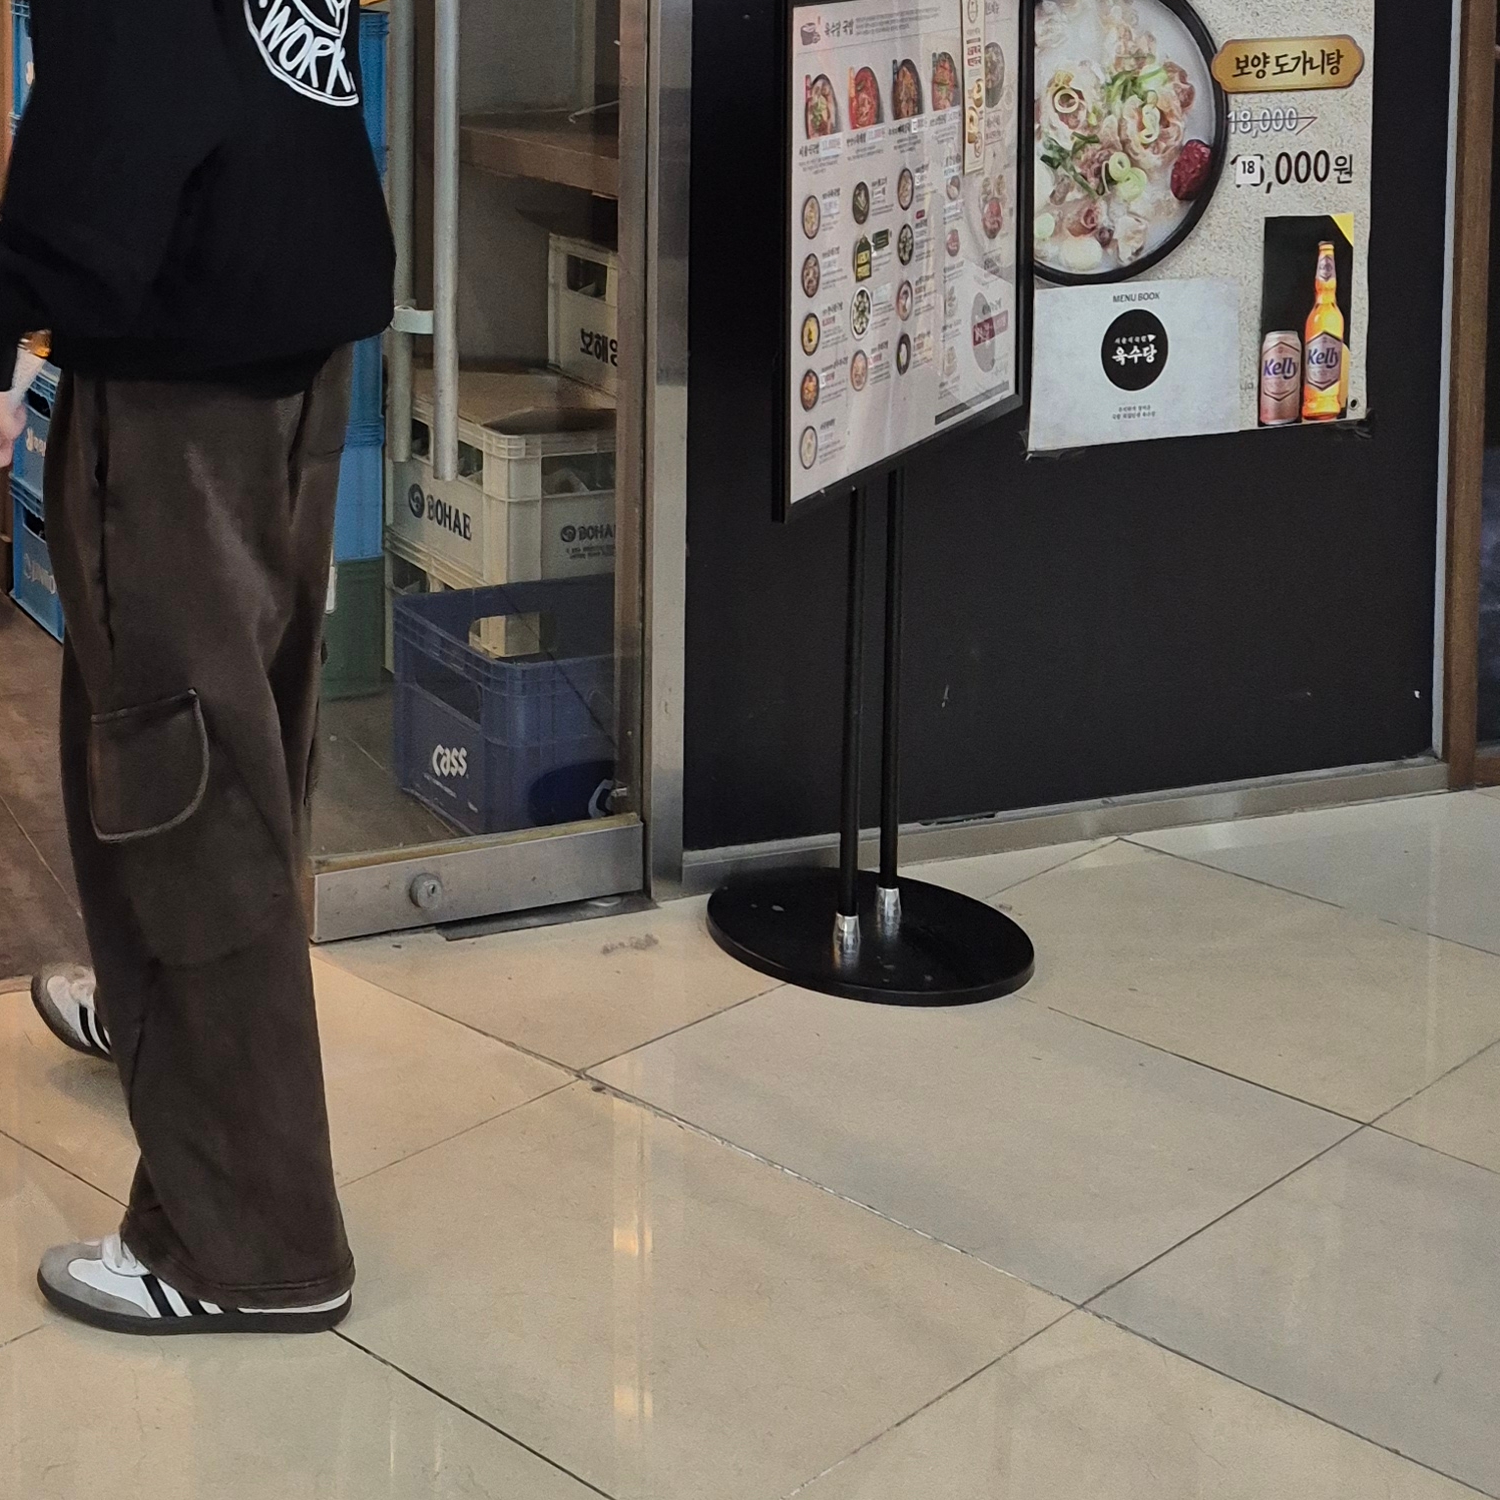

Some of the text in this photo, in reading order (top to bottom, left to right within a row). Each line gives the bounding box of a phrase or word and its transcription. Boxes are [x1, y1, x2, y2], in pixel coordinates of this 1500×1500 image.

[1232, 49, 1344, 79] 보양 도가니탕
[1227, 107, 1298, 138] 18,000
[1113, 292, 1160, 302] MENU BOOK
[1112, 345, 1157, 366] 육수당
[1306, 347, 1341, 369] Kelly
[1263, 357, 1299, 380] Kelly
[426, 494, 472, 541] BOHAE
[578, 524, 617, 541] BOHA
